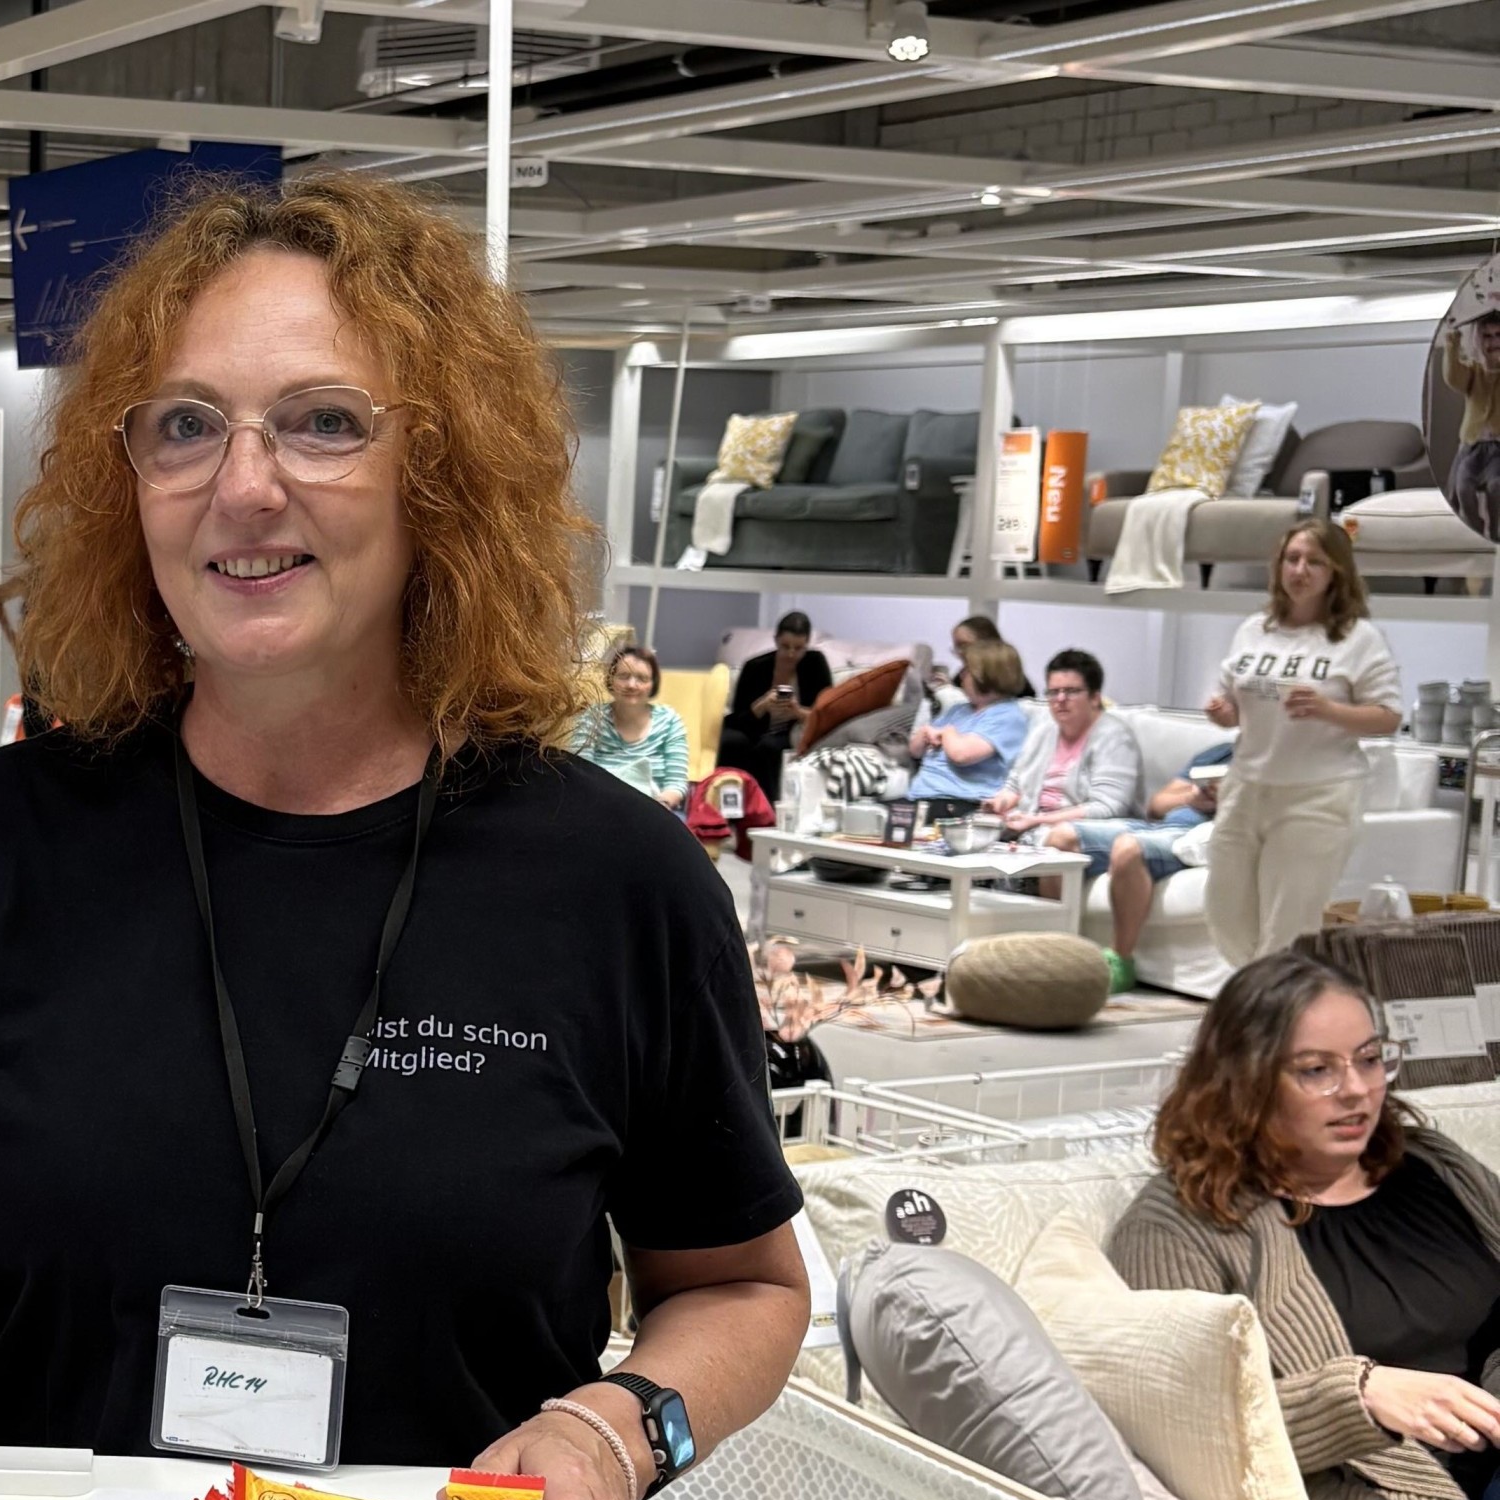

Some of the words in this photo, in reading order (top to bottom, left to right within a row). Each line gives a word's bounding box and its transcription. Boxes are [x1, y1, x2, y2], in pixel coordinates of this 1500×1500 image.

[1045, 464, 1068, 523] Neu
[366, 1016, 410, 1039] ist
[417, 1014, 454, 1038] du
[462, 1023, 548, 1051] schon
